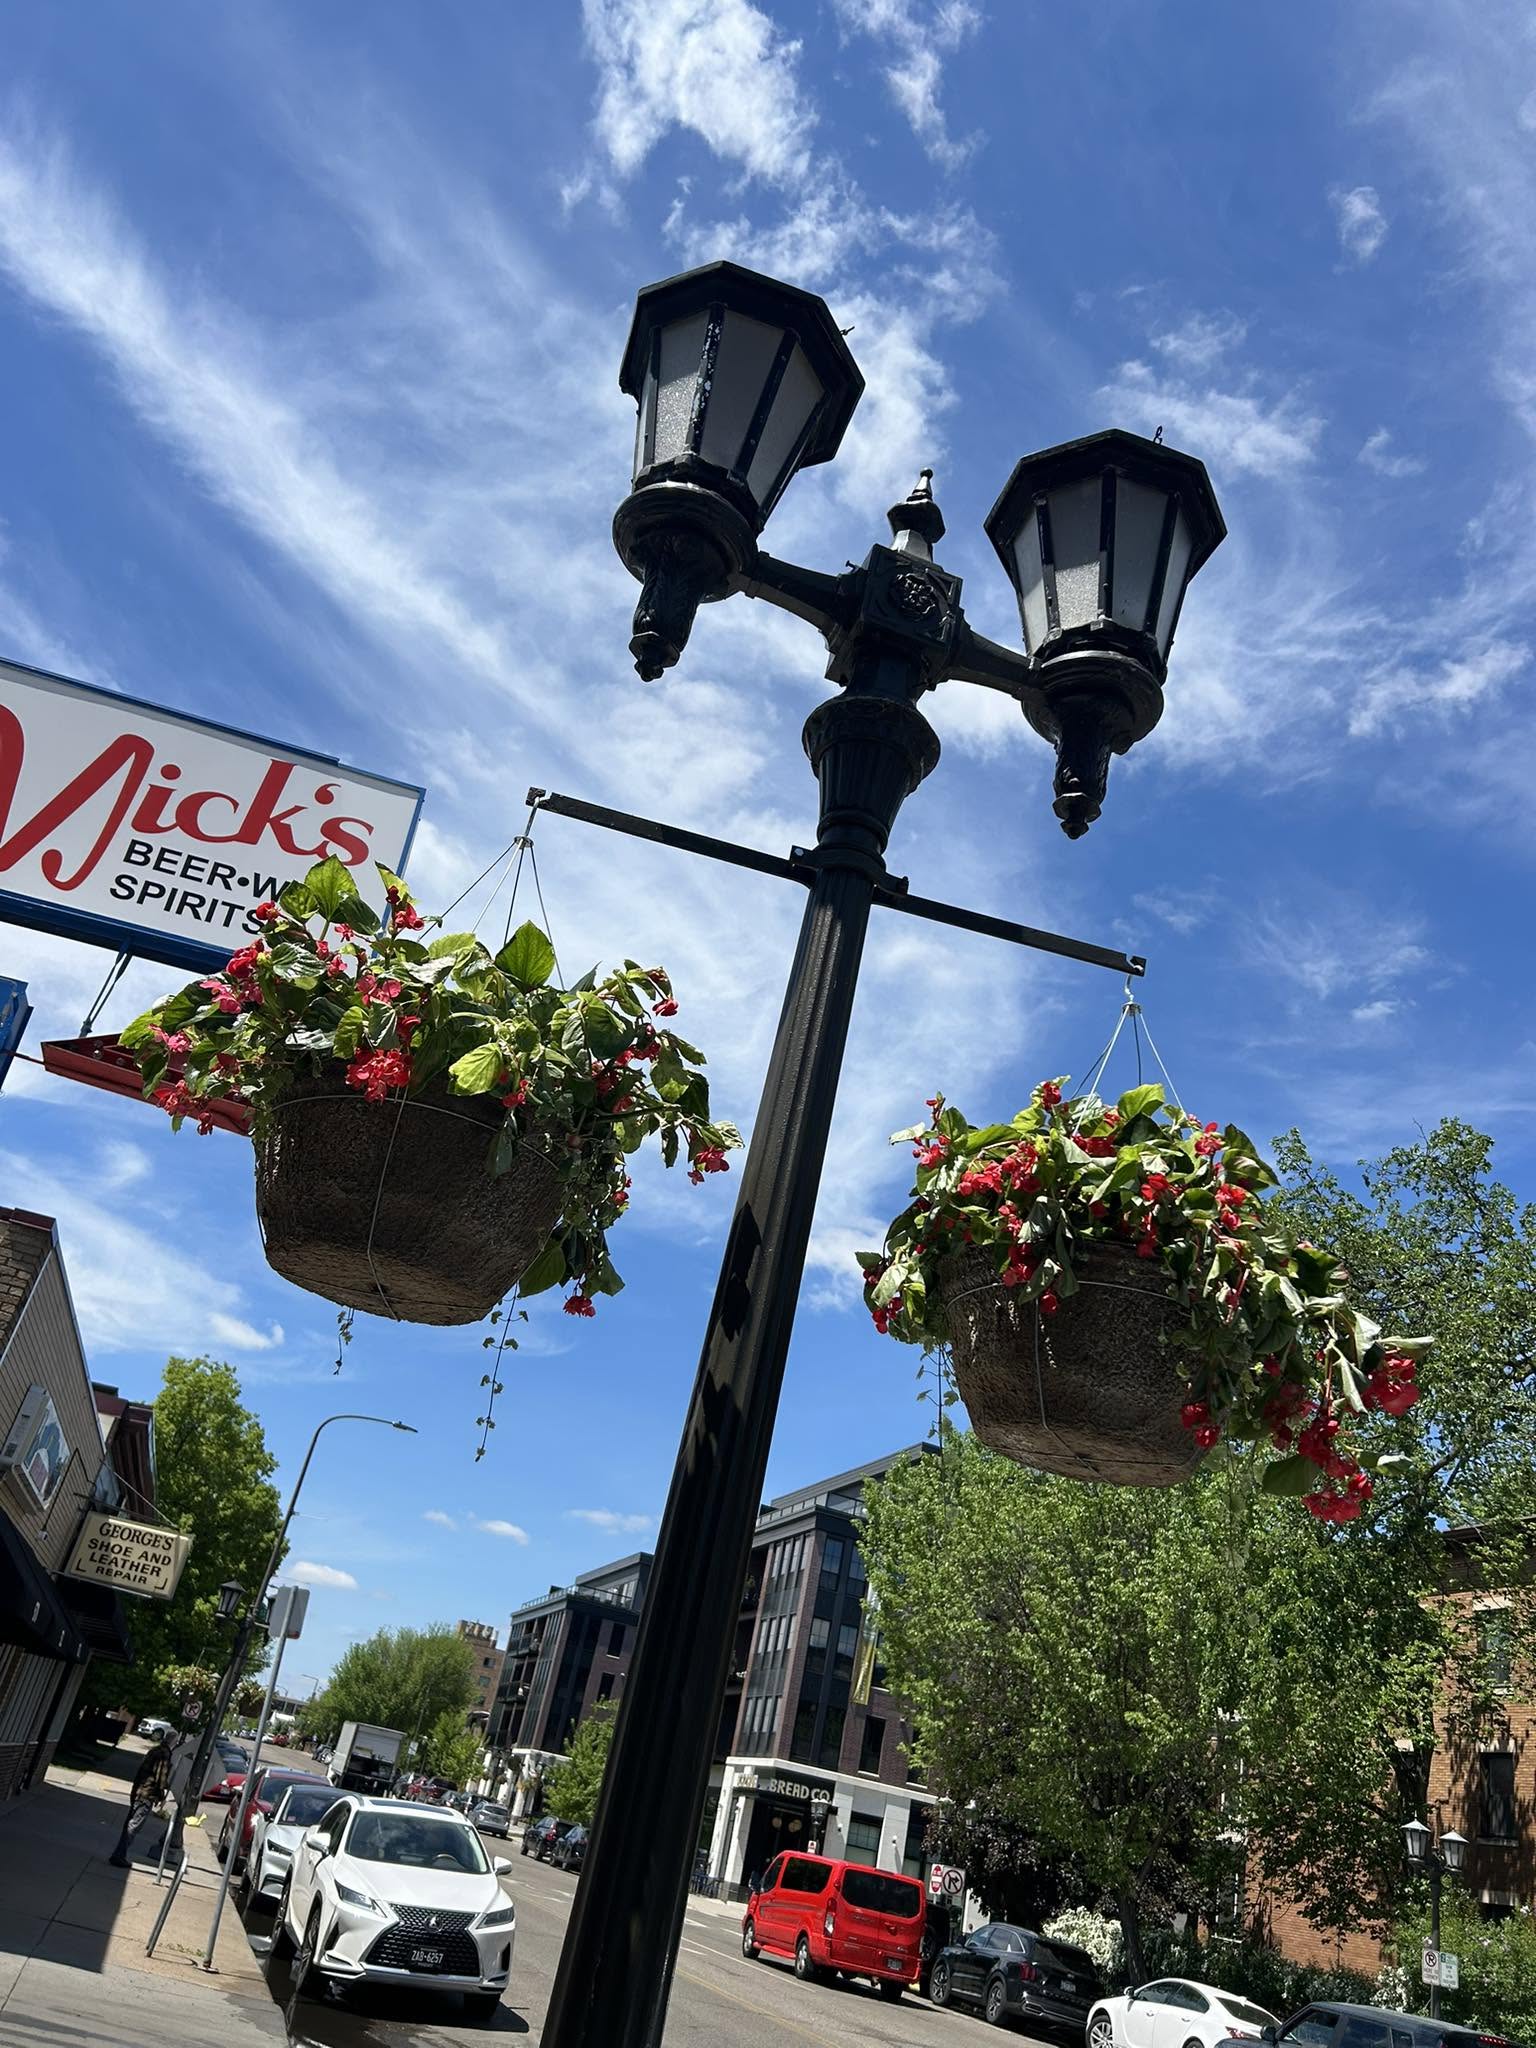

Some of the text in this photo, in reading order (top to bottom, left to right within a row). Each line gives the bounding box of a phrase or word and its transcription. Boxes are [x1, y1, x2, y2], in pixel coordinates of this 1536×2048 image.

[109, 873, 266, 935] SPIRITS
[99, 1521, 174, 1551] GEORGE'S
[87, 1538, 172, 1566] SHOE AND
[89, 1552, 161, 1577] LEATHER
[95, 1566, 148, 1585] REPAIR
[769, 1777, 810, 1800] BREAD
